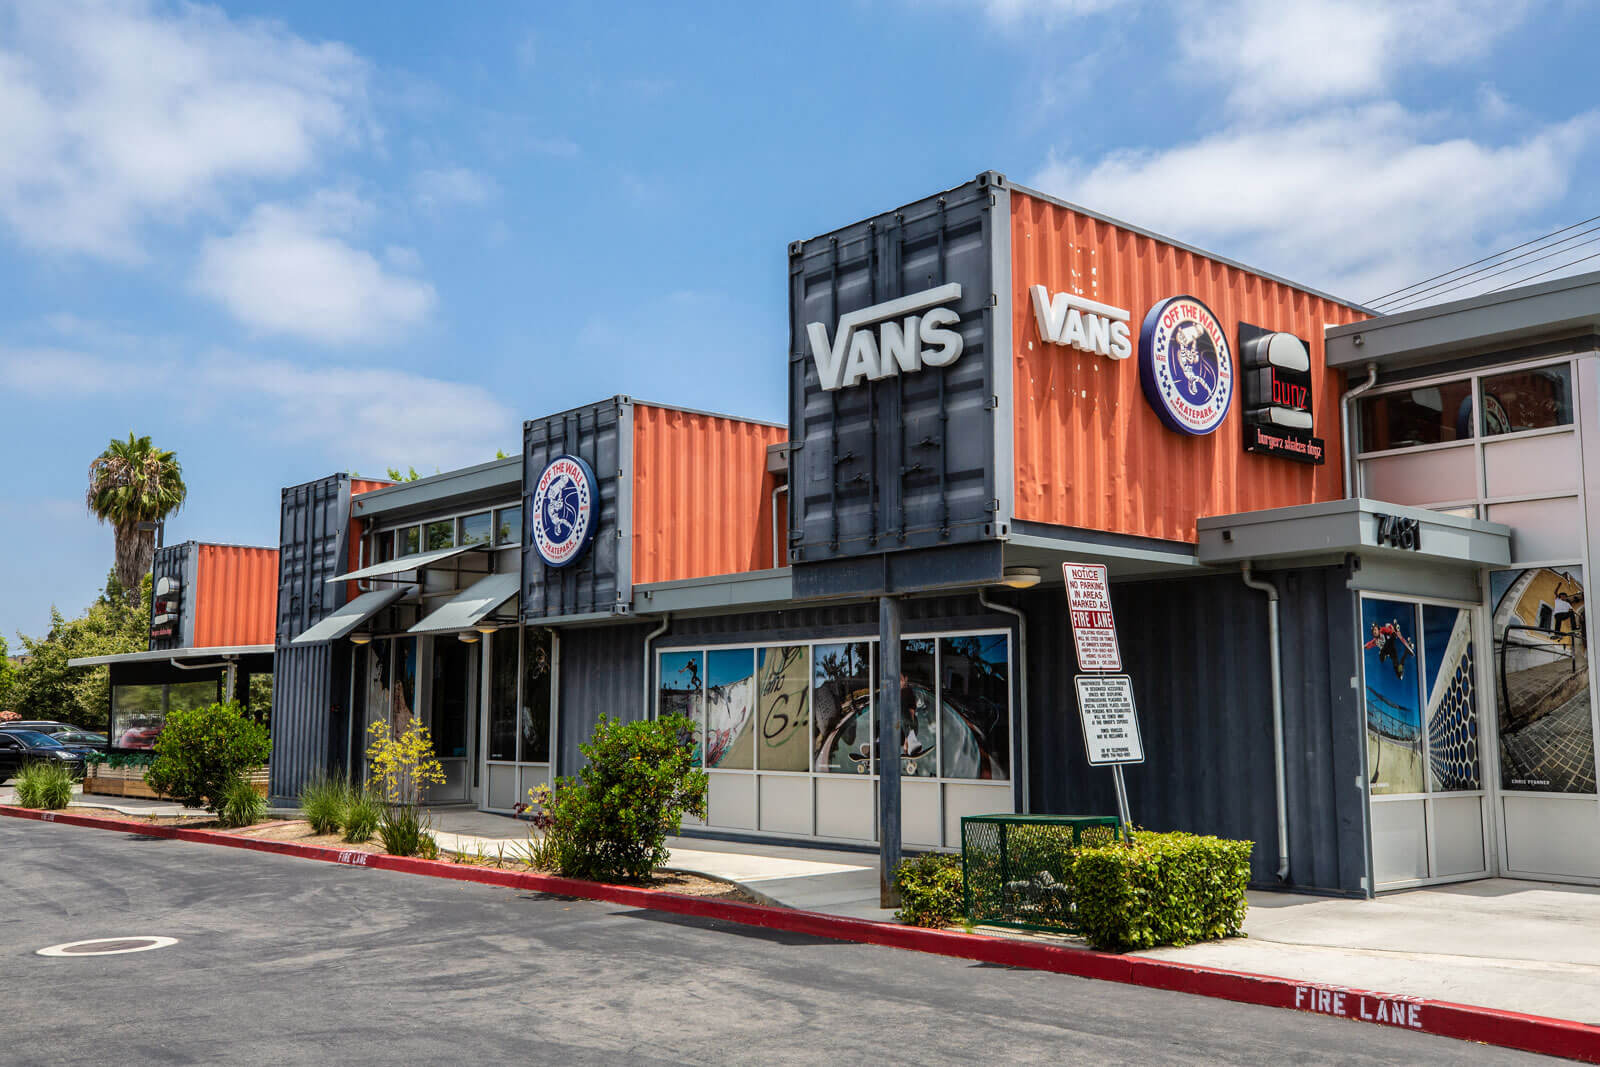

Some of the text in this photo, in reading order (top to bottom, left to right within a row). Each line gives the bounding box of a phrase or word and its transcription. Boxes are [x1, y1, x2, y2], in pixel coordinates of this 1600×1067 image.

[1029, 284, 1132, 360] VANS
[1163, 304, 1221, 346] OFF THE WALL
[807, 282, 963, 391] VANS
[1272, 366, 1307, 409] bunz
[1175, 397, 1213, 419] SKATEPARK
[1257, 428, 1283, 449] burgerz
[540, 462, 583, 491] OFF THE WALL
[545, 540, 573, 554] SKATEPARK
[1072, 569, 1098, 579] NOTICE
[1070, 581, 1104, 590] NO PARKING
[1074, 590, 1103, 600] IN AREAS
[1072, 600, 1109, 609] MARKED AS
[1073, 612, 1113, 628] FIRE LANE
[1295, 986, 1422, 1028] FIRE LANE
